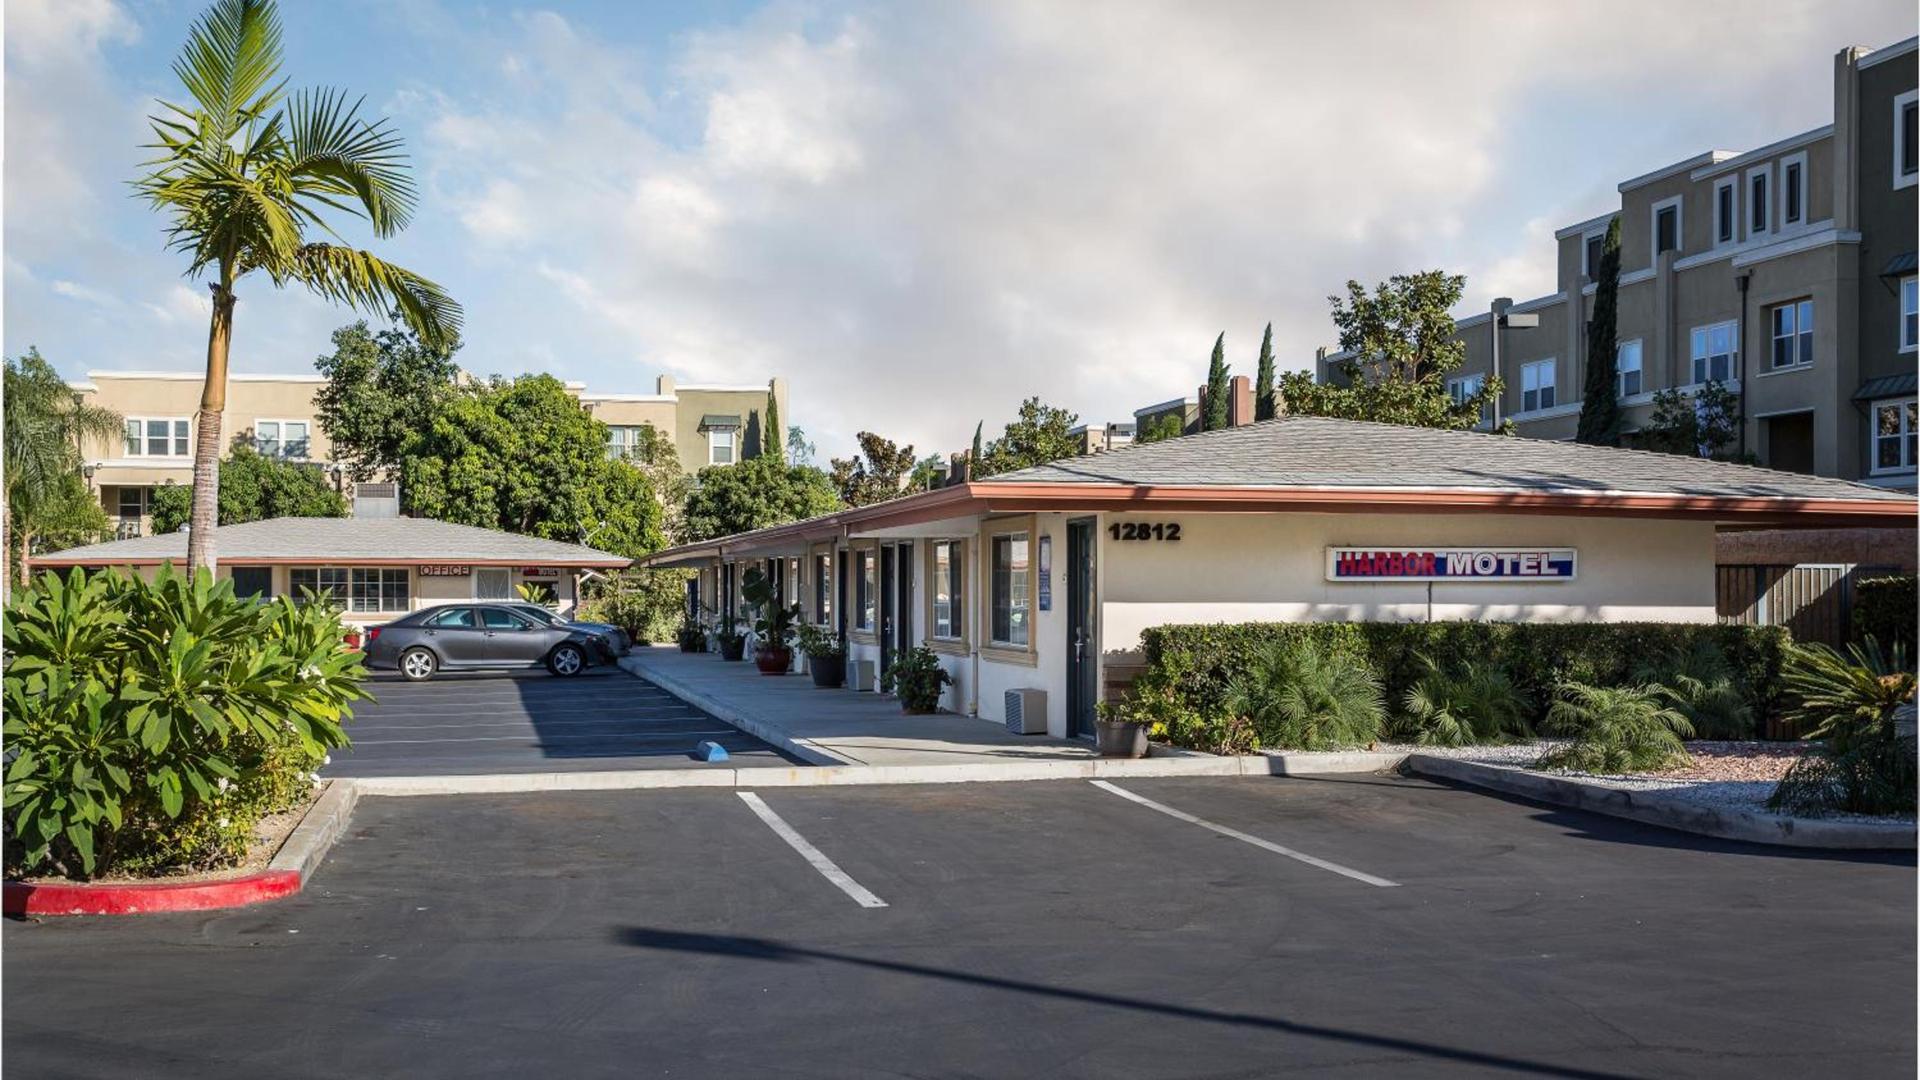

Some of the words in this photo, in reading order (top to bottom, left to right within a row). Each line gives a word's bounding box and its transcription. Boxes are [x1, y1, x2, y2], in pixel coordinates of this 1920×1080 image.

[1108, 523, 1181, 541] 12812
[421, 565, 470, 576] OFFICE
[1340, 552, 1436, 576] HARBOR
[1446, 552, 1559, 575] MOTEL
